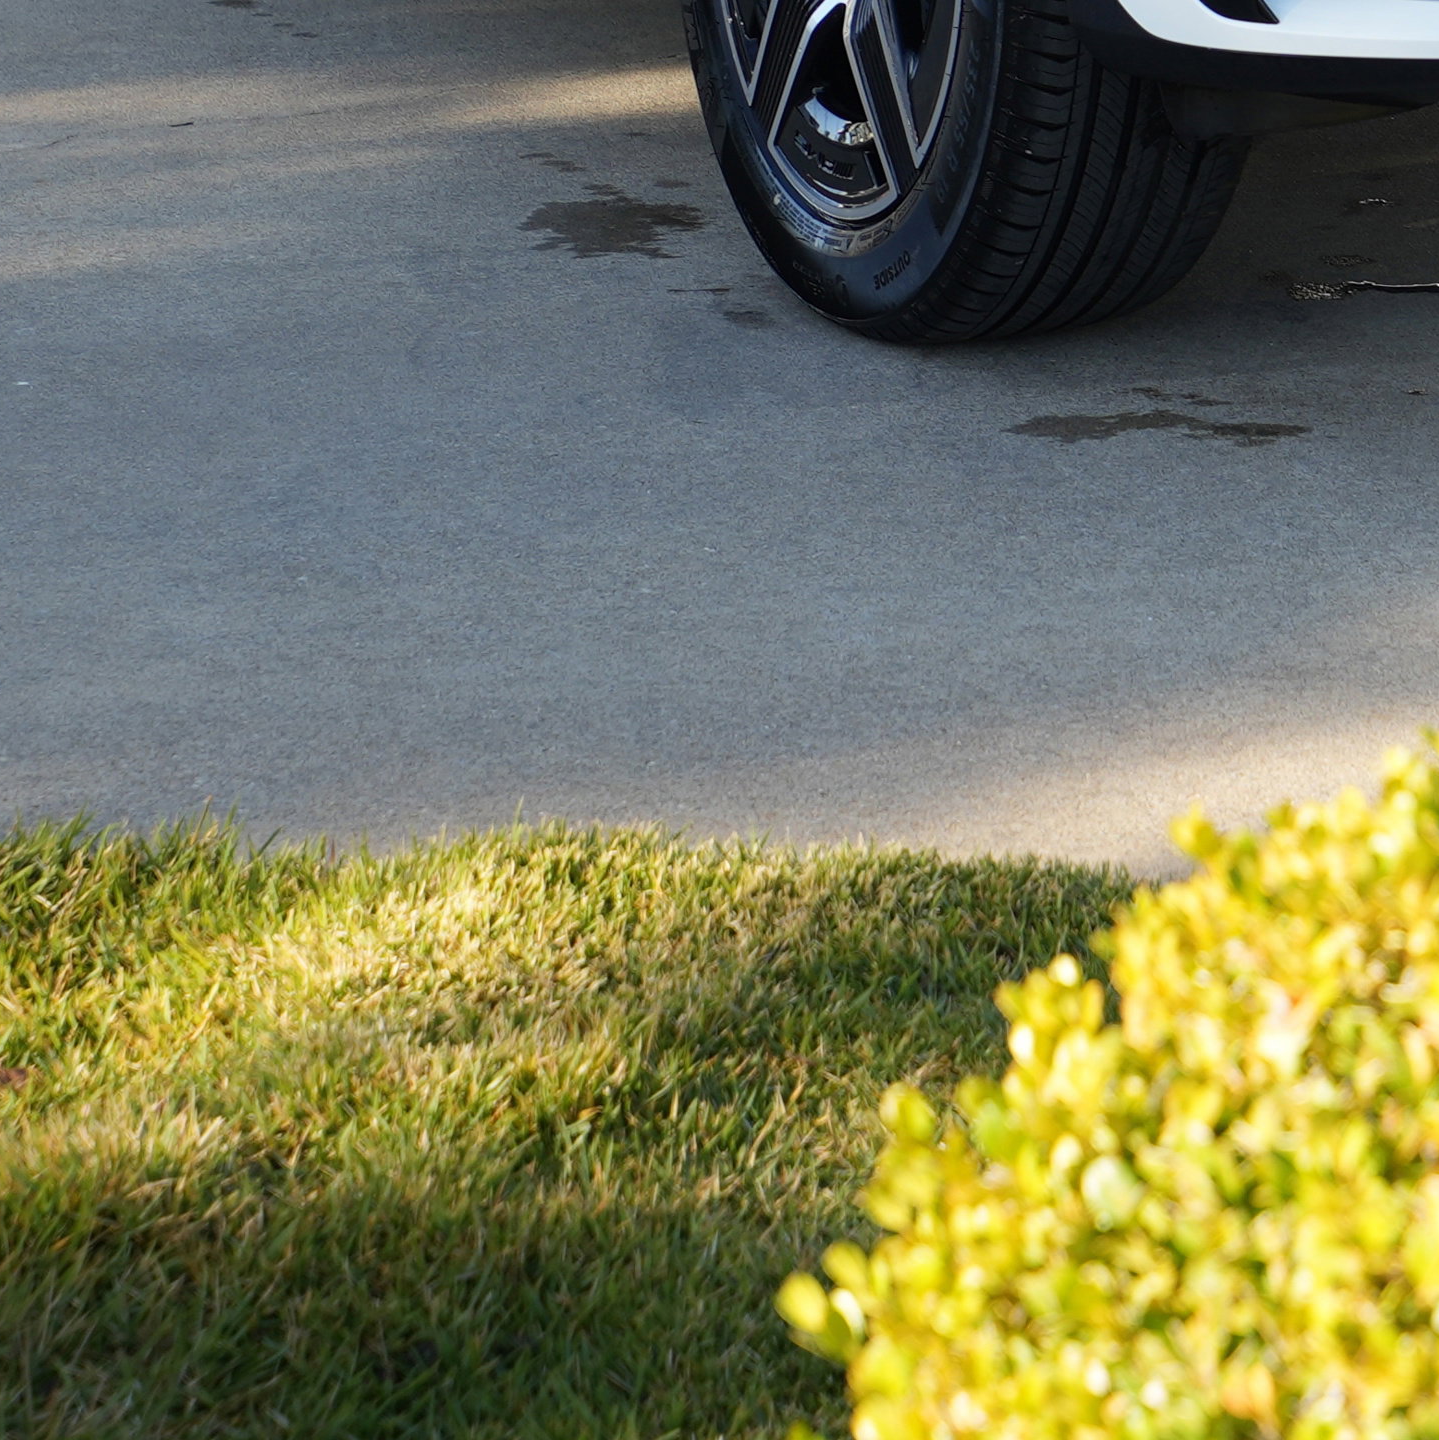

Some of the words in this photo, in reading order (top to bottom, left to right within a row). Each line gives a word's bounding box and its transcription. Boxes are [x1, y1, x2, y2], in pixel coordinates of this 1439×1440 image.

[955, 39, 980, 147] 235/55
[946, 152, 958, 173] R
[873, 250, 911, 290] OUTSIDE
